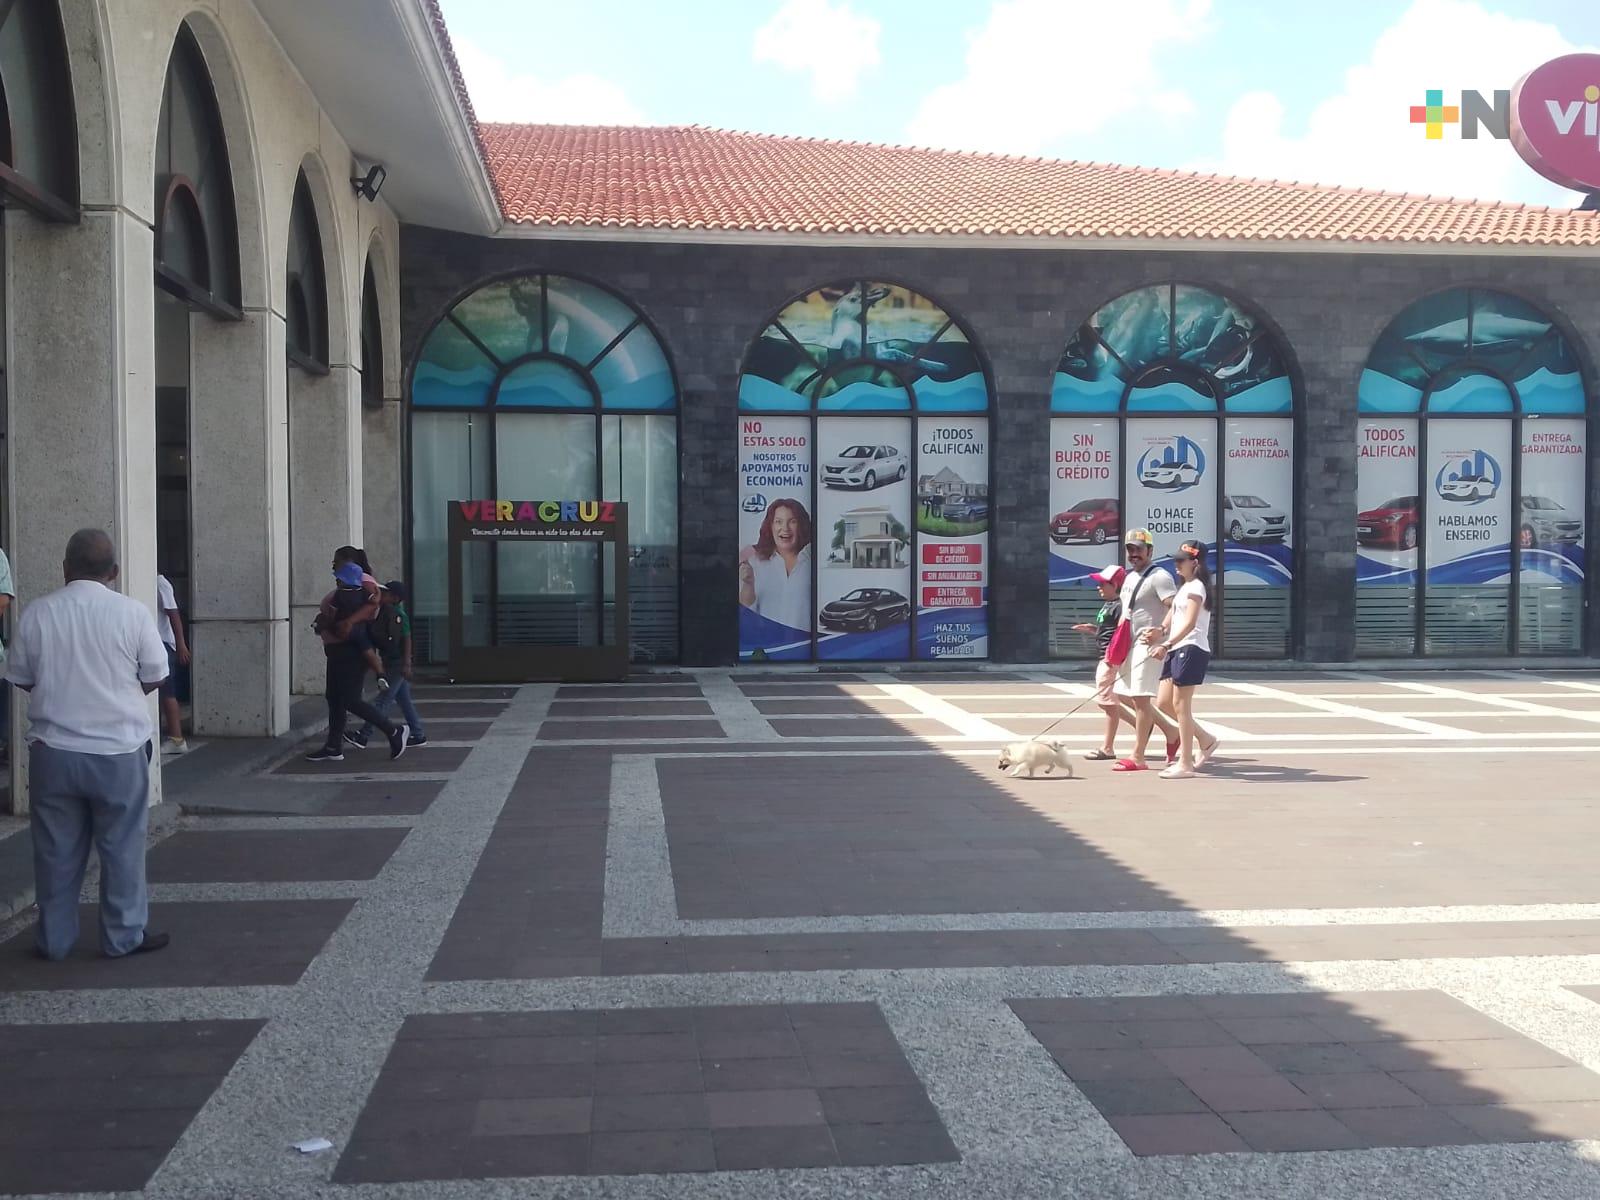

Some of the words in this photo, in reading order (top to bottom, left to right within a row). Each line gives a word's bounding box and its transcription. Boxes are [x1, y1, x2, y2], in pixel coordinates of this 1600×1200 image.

[1544, 85, 1600, 153] vi
[744, 422, 762, 433] NO
[1073, 434, 1094, 446] SIN
[1364, 429, 1405, 441] TODOS
[1533, 433, 1572, 443] ENTREGA
[744, 437, 775, 446] ESTAS
[779, 437, 806, 446] SOLO
[1240, 438, 1279, 447] ENTREGA
[922, 443, 984, 454] CALIFICAN!
[1229, 450, 1290, 458] GARANTIZADA
[1095, 450, 1111, 463] DE
[741, 464, 794, 472] APOYAMOS
[797, 464, 809, 472] TU
[746, 474, 804, 486] ECONOMÍA
[460, 500, 616, 522] VERACRUZ
[1147, 508, 1161, 519] LO
[1165, 508, 1194, 519] HACE
[1438, 515, 1498, 527] HABLAMOS
[1147, 522, 1194, 534] POSIBLE
[1446, 530, 1490, 541] ENSERIO
[938, 587, 967, 597] ENTREGA
[930, 597, 974, 606] GARANTIZADA
[955, 624, 971, 632] TUS
